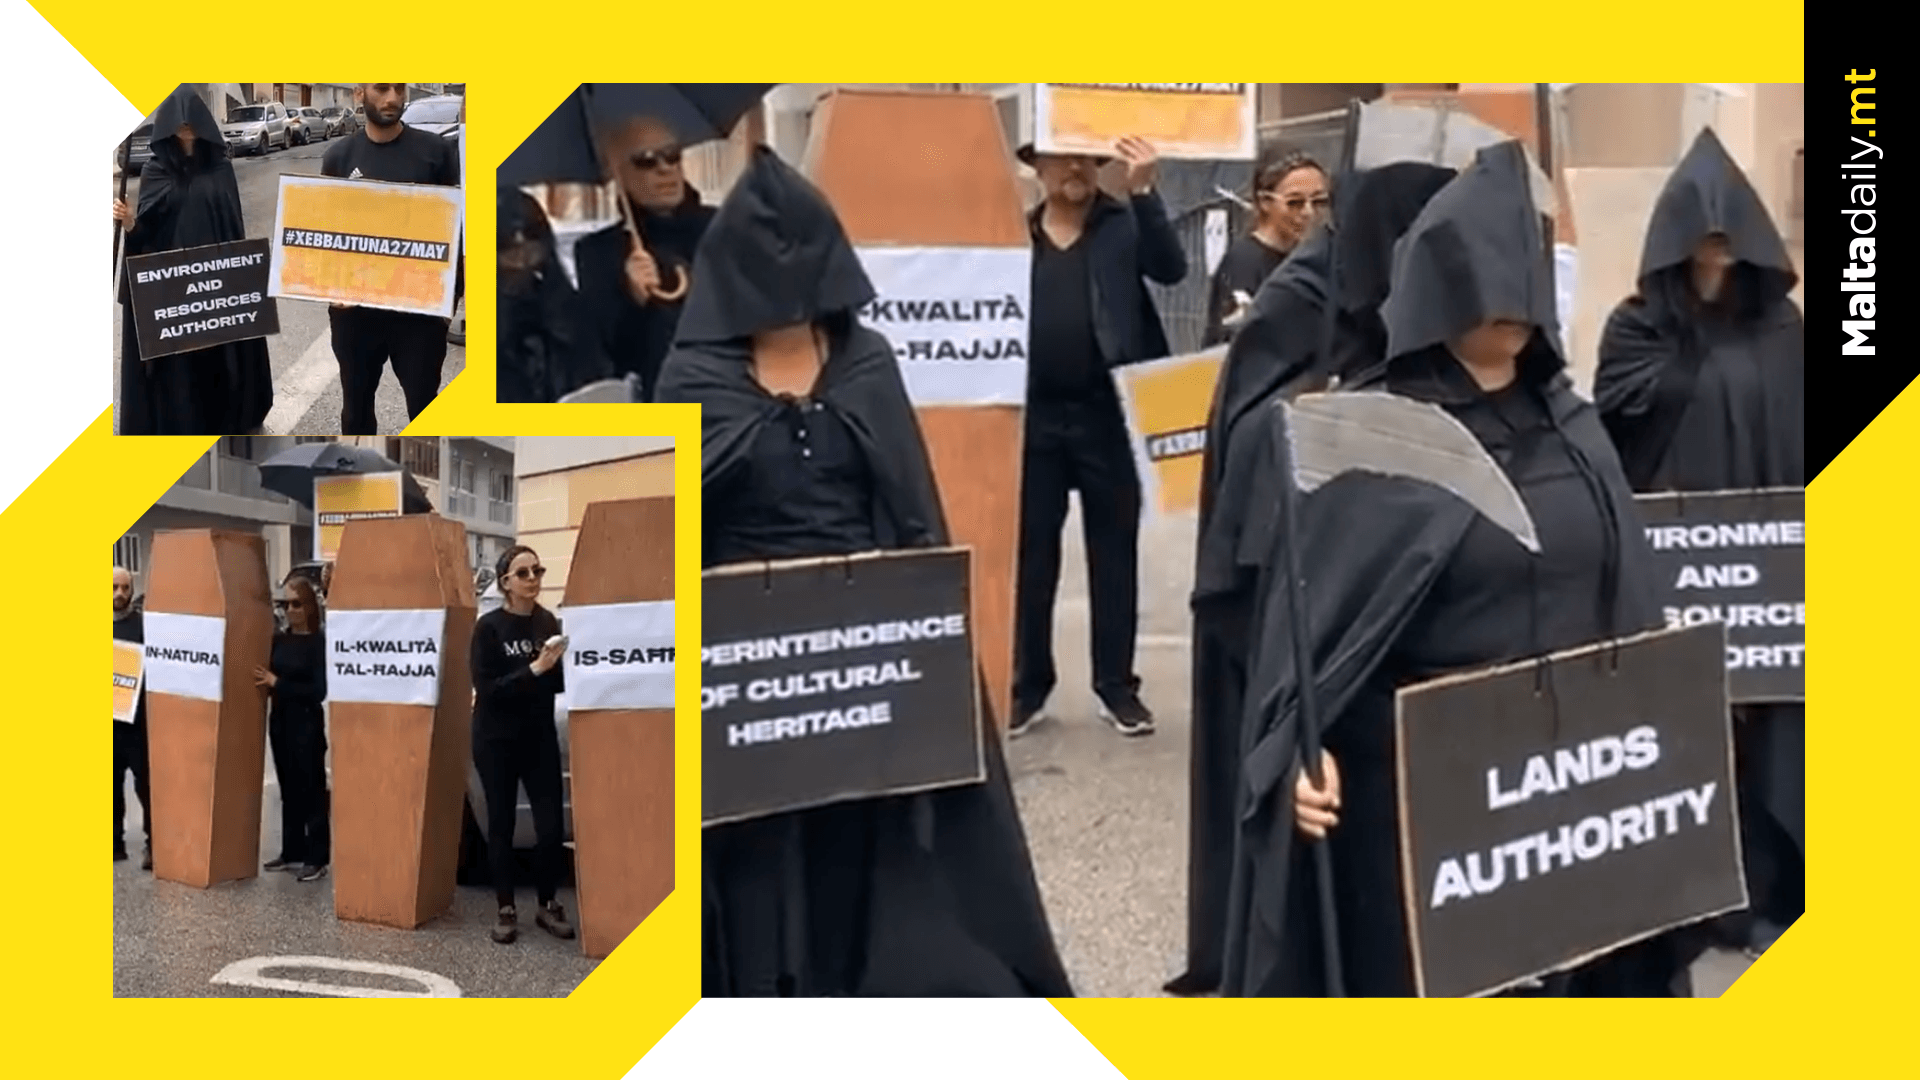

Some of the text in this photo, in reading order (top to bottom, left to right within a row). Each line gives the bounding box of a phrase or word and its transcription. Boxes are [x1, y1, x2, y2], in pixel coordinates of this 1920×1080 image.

[285, 230, 447, 260] #XEBBAJTUNA27MAY
[137, 253, 264, 284] ENVIRONMENT
[185, 279, 223, 295] AND
[154, 292, 262, 320] RESOURCES
[159, 311, 258, 340] AUTHORITY
[1675, 564, 1760, 589] AND
[146, 646, 220, 666] IN-NATURA
[335, 637, 437, 653] IL-KWALITÀ
[335, 663, 436, 677] TAL-ĦAJJA
[746, 659, 922, 701] CULTURAL
[728, 702, 892, 746] HERITAGE
[1487, 726, 1659, 810] LANDS
[1431, 782, 1716, 909] AUTHORITY
